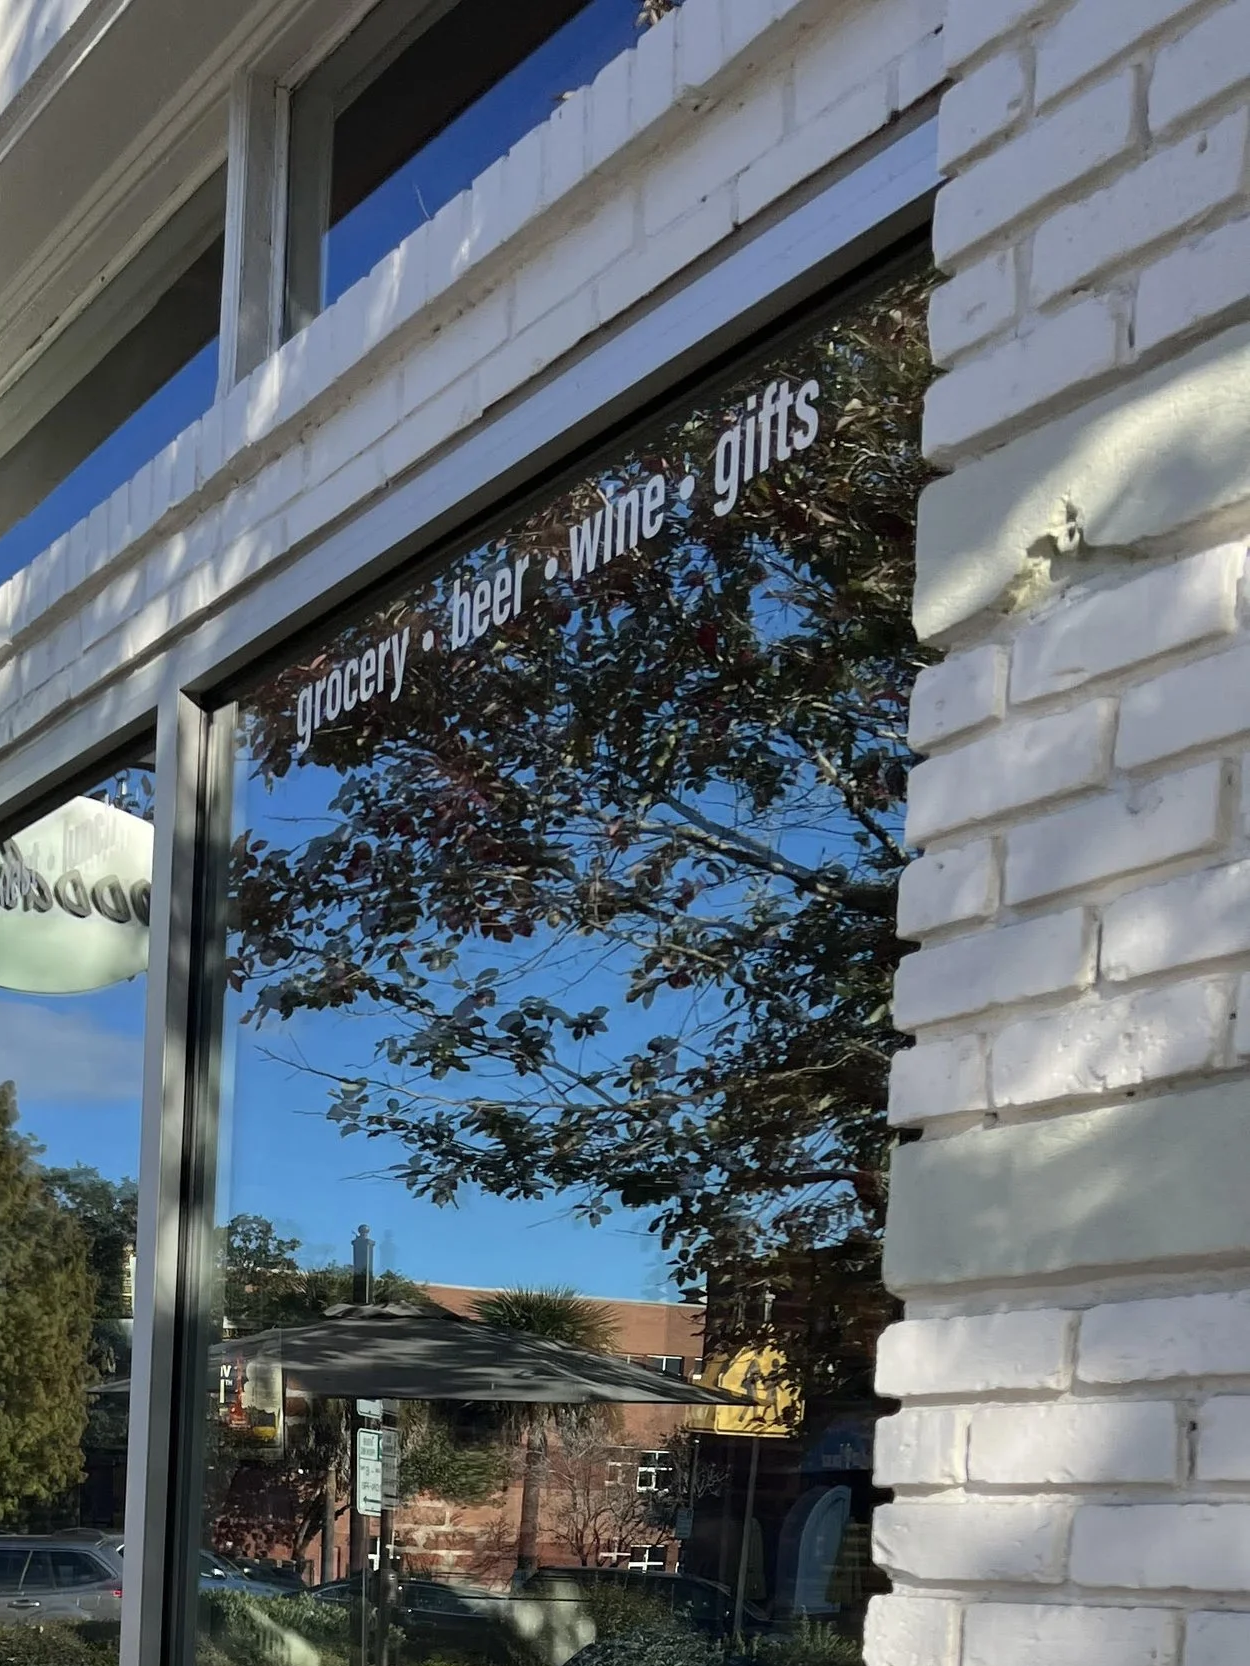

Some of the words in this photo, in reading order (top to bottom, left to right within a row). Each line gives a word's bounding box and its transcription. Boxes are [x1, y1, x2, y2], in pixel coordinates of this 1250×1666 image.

[296, 626, 411, 753] grocery
[450, 555, 530, 652] beer
[569, 472, 666, 582] wine
[713, 378, 820, 517] gifts
